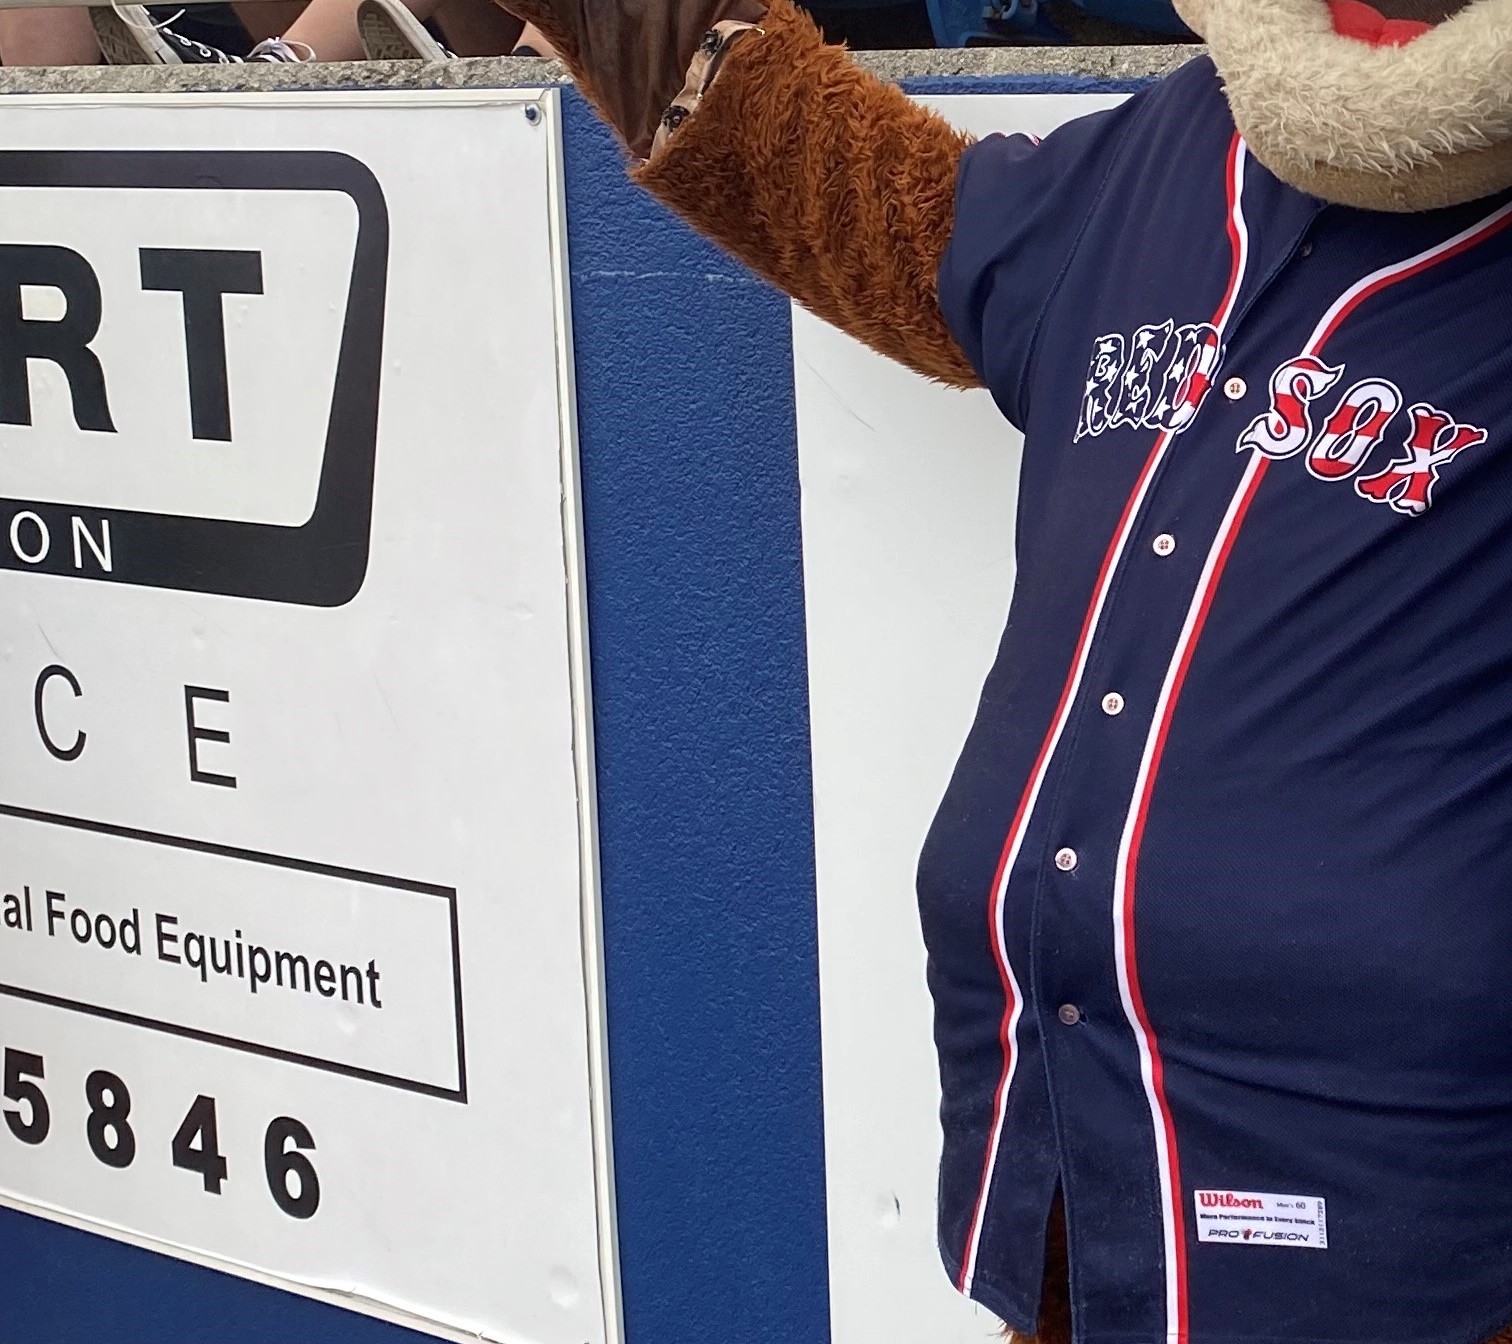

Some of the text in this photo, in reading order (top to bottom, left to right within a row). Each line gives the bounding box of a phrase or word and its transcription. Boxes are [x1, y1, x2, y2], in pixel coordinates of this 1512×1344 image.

[0, 243, 264, 442] RT
[1073, 317, 1489, 517] RED SOX
[9, 510, 114, 573] ON
[3, 885, 383, 1009] al Food Equipment
[2, 1046, 321, 1221] 5846
[1199, 1193, 1264, 1210] Wilson
[1208, 1229, 1310, 1243] PRO FUSION
